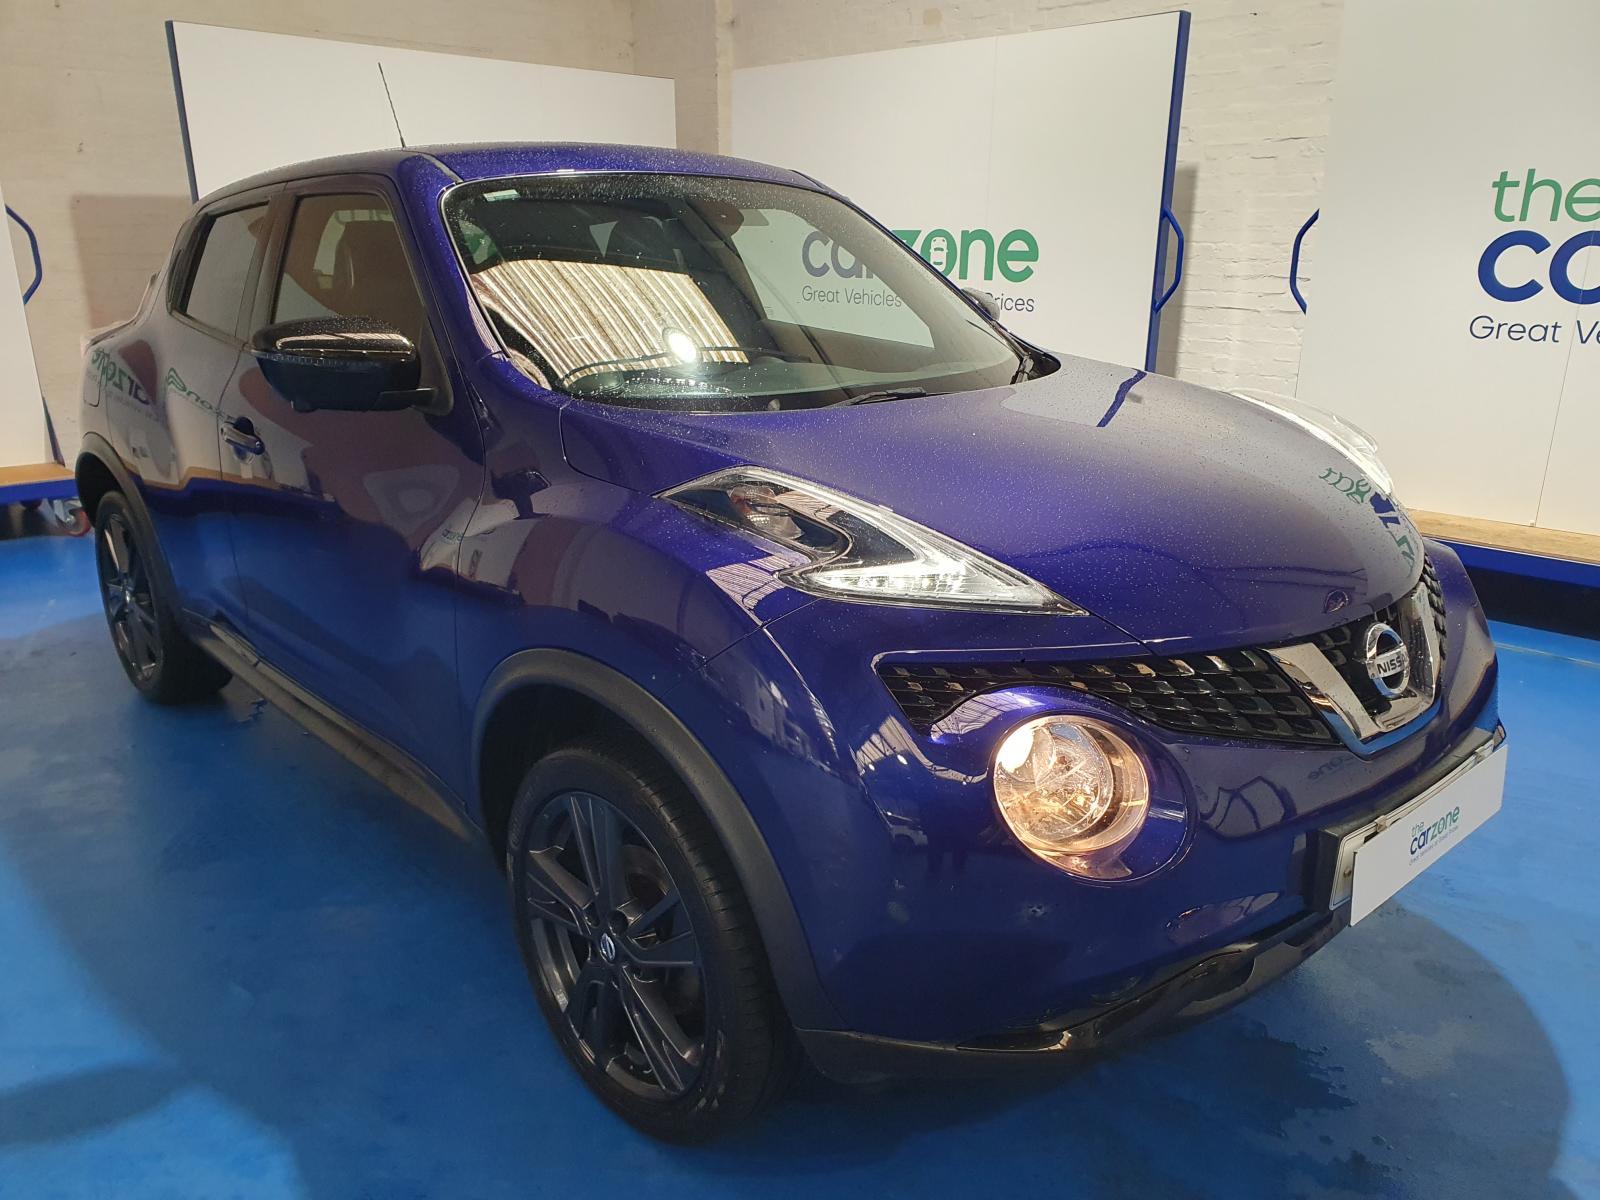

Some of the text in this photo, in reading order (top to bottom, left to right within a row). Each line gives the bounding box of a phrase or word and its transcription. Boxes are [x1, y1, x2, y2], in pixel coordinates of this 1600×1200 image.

[801, 228, 1039, 282] caone
[801, 285, 1035, 313] Great Vehicles ices
[1469, 315, 1600, 344] Great V
[1377, 653, 1405, 674] NISS
[1410, 806, 1460, 855] carzone
